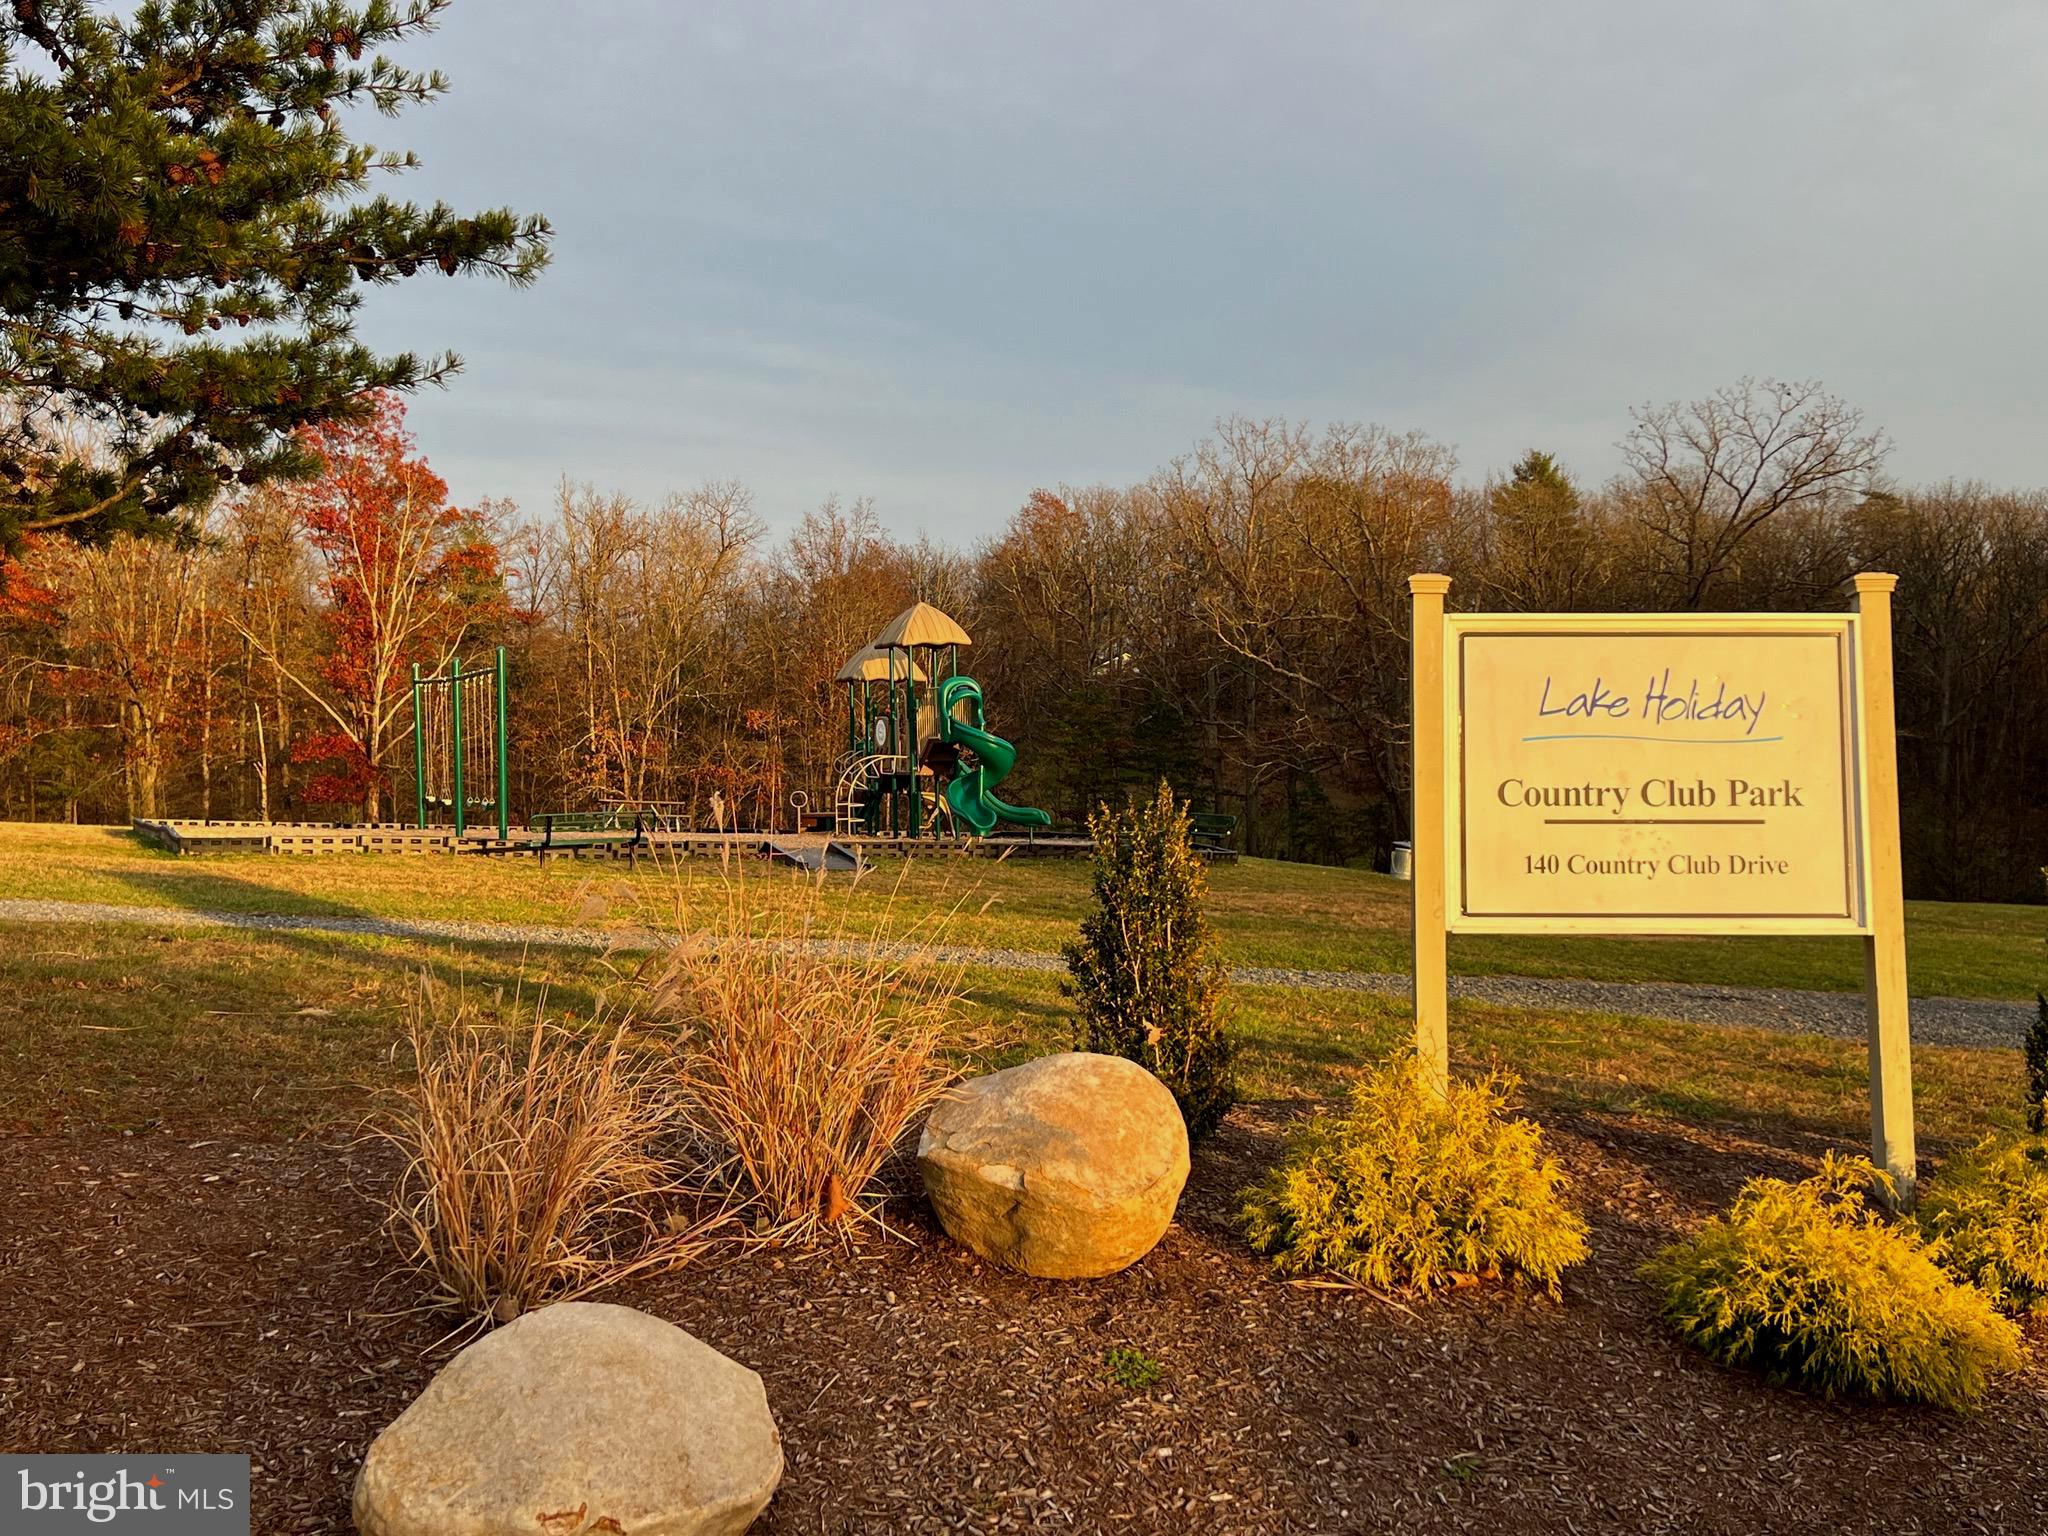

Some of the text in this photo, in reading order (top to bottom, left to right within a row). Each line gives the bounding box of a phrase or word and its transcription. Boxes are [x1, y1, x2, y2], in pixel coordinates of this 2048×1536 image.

[1538, 667, 1766, 735] Lake Holiday
[1497, 778, 1805, 815] Country Club Park
[1523, 854, 1790, 880] 140 Country Club Drive
